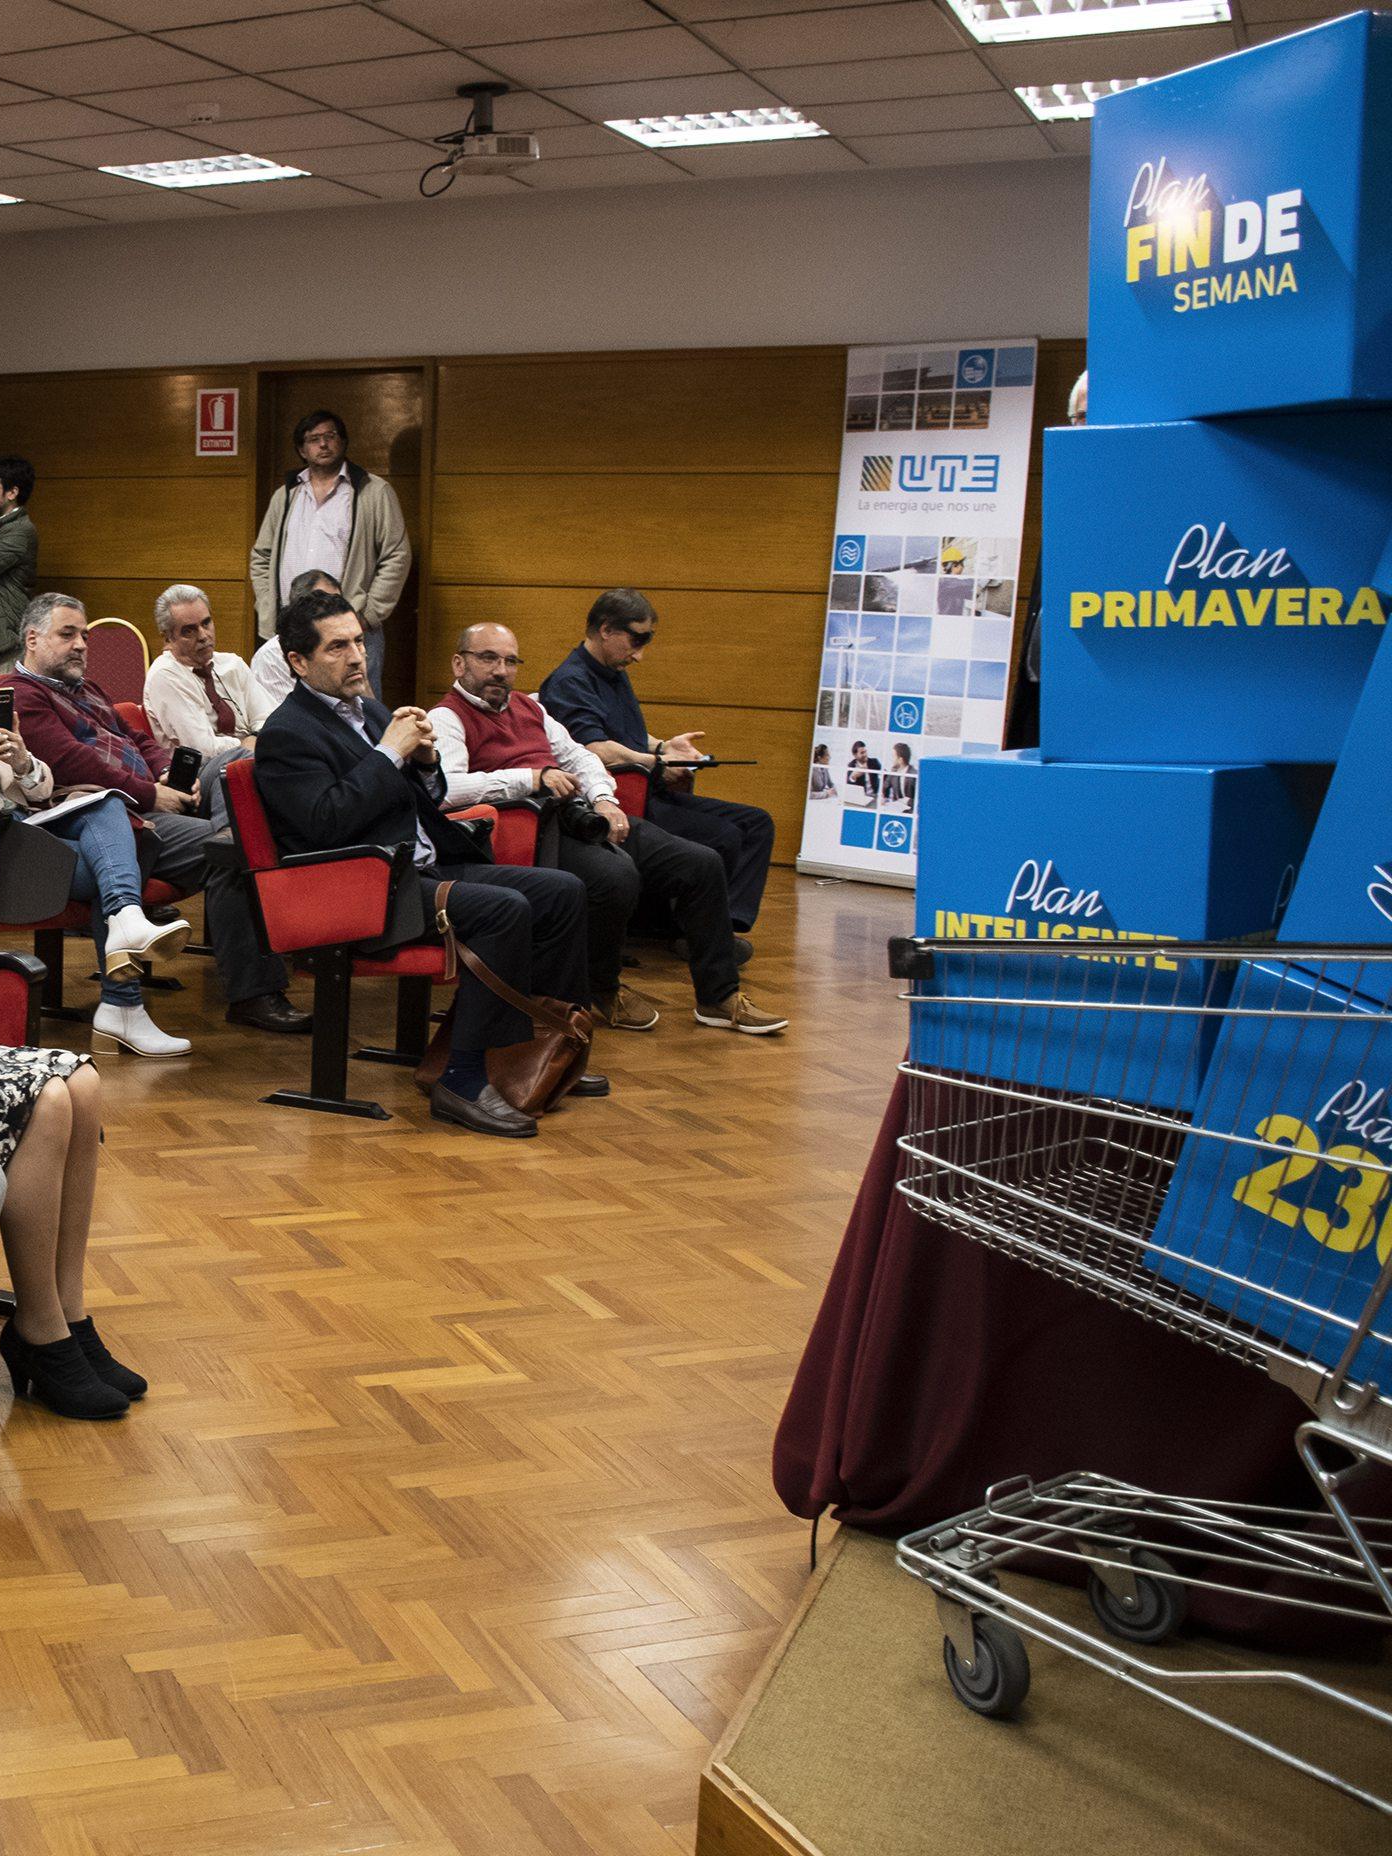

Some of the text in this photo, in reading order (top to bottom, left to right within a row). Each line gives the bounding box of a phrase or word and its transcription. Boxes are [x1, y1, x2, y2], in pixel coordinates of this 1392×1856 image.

[1123, 156, 1210, 227] Plan
[1126, 188, 1302, 284] FIN DE
[1173, 262, 1298, 313] SEMANA
[898, 454, 1000, 493] UTE
[858, 499, 870, 511] La
[921, 502, 944, 513] que
[947, 502, 969, 513] nos
[972, 503, 997, 513] une
[1164, 521, 1291, 585] Plan
[1069, 586, 1387, 629] PRIMAVERA
[1005, 859, 1103, 918] Plan
[1315, 1079, 1392, 1150] Pla
